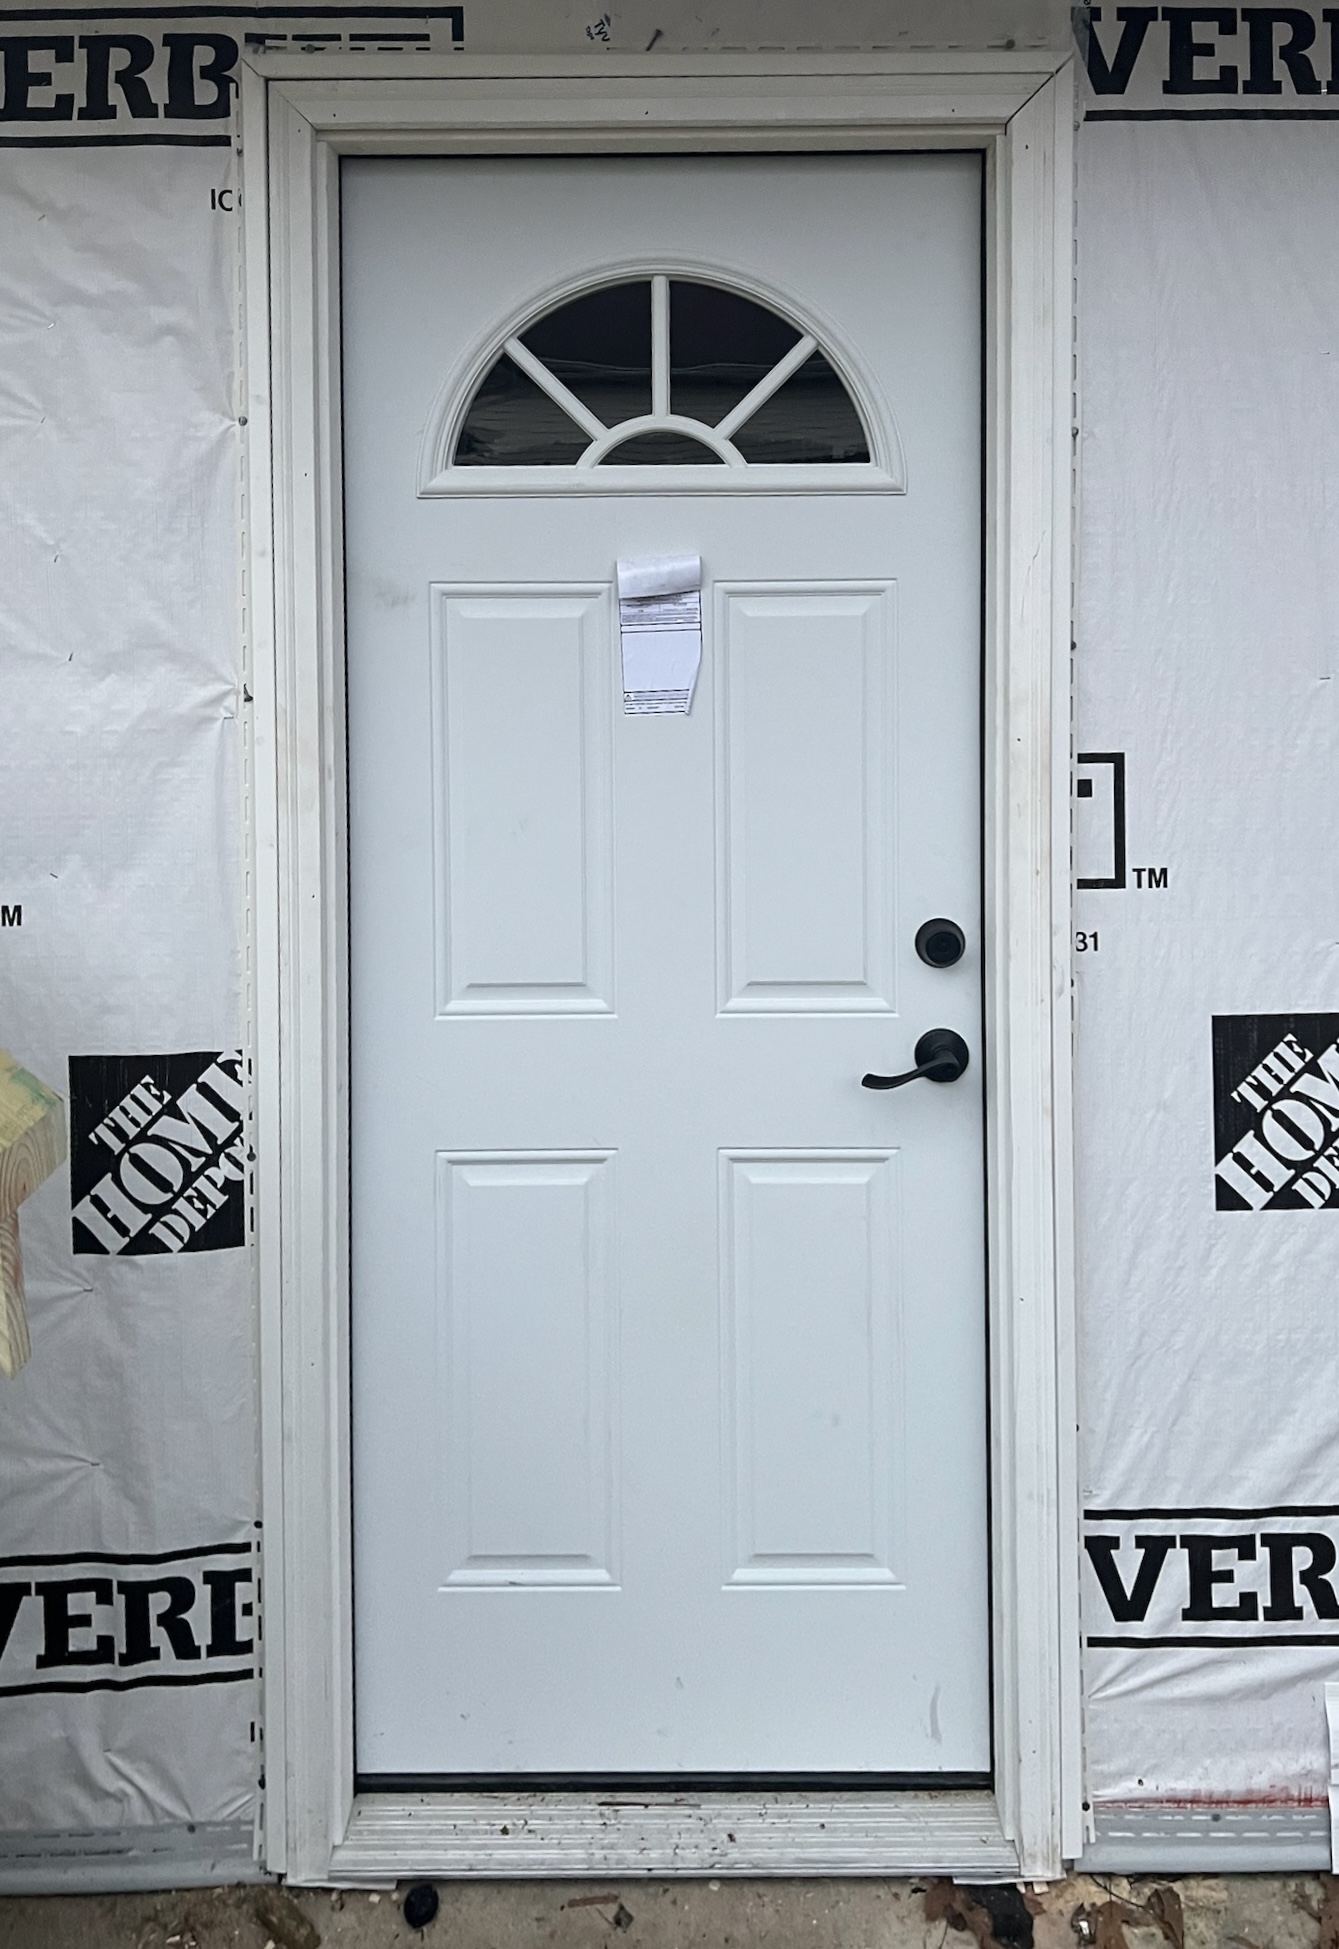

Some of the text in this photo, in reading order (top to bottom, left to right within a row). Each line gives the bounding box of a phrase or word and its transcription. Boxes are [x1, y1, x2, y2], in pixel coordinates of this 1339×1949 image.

[1071, 6, 1339, 95] VER
[211, 188, 242, 212] IC
[1132, 867, 1168, 889] TM
[1076, 931, 1098, 952] 31
[1230, 1033, 1314, 1113] THE
[88, 1075, 172, 1155] THE
[1215, 1038, 1339, 1211] HOM
[149, 1134, 245, 1254] DEPO
[1291, 1138, 1339, 1211] DE
[1084, 1532, 1339, 1622] VER
